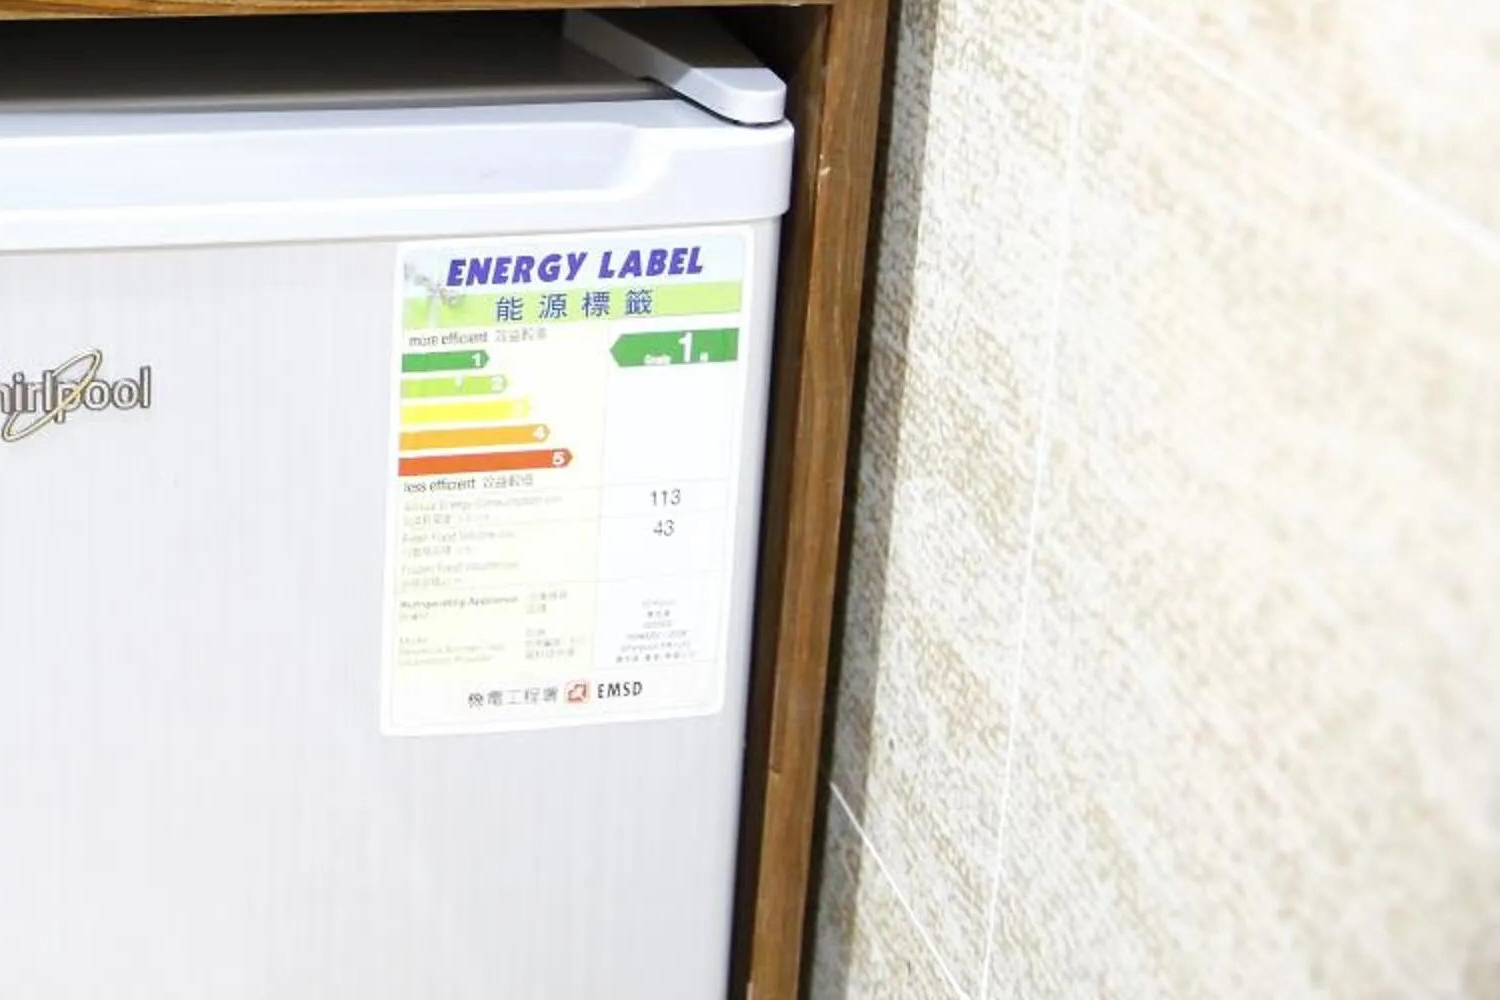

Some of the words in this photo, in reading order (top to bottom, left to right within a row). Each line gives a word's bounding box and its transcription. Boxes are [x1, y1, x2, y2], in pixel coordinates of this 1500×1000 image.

[446, 251, 588, 287] ENERGY
[597, 246, 705, 280] LABEL
[494, 288, 655, 323] 能源標籤
[408, 334, 439, 347] more
[441, 330, 488, 346] efficient
[678, 331, 693, 363] 1
[471, 352, 483, 367] 1
[532, 426, 546, 441] 4
[552, 452, 565, 467] 5
[403, 479, 427, 493] less
[430, 477, 476, 492] efficient
[650, 488, 682, 507] 113
[653, 519, 675, 538] 43
[597, 680, 643, 700] EMSD
